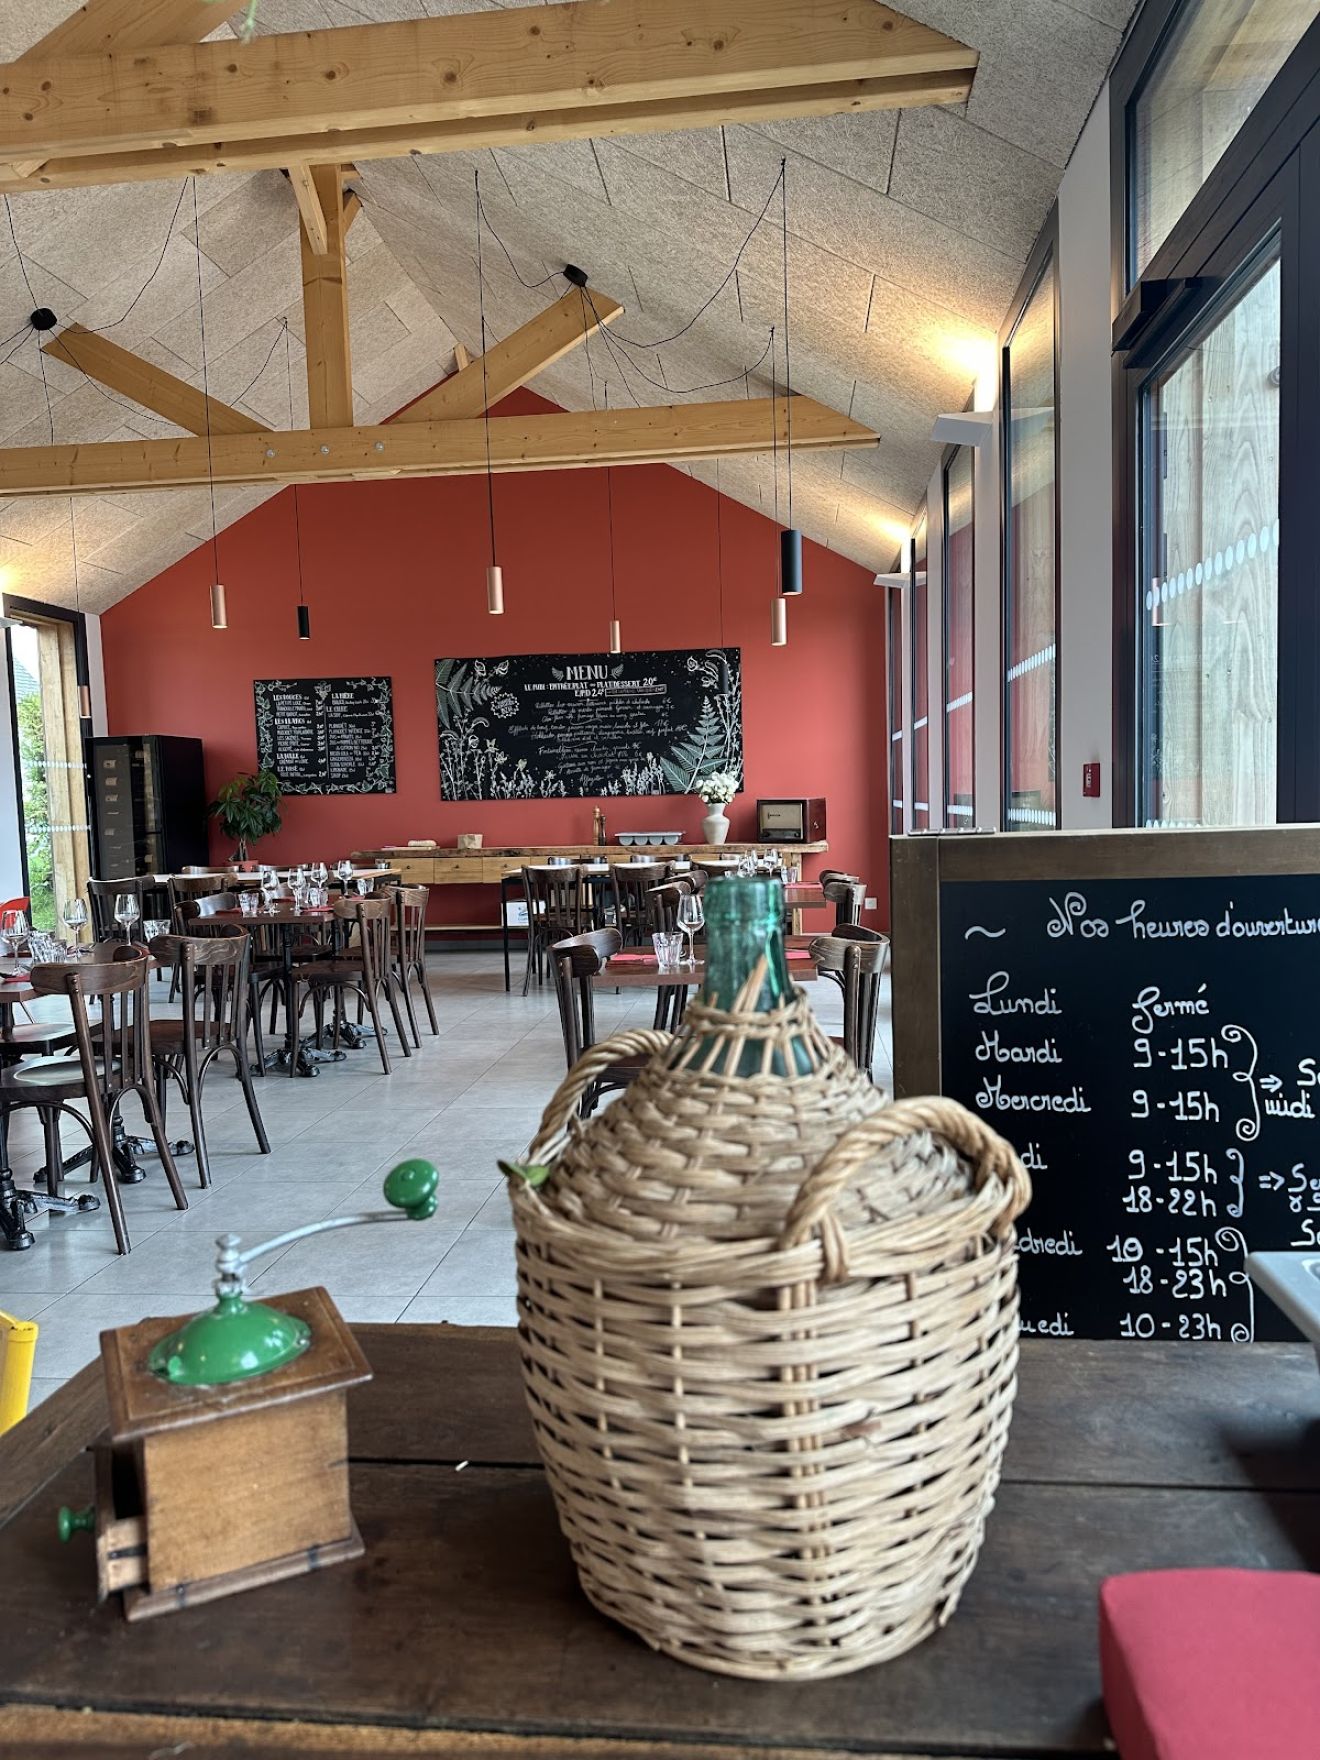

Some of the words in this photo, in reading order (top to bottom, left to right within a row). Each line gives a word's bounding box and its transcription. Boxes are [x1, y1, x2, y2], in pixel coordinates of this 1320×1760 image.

[566, 664, 608, 680] MENU
[1047, 892, 1109, 938] Nos
[1115, 900, 1210, 939] heures
[1216, 901, 1320, 937] d'ouvertur
[969, 971, 1062, 1015] Lundi
[975, 1030, 1062, 1063] Mardi
[975, 1074, 1092, 1112] Mercredi
